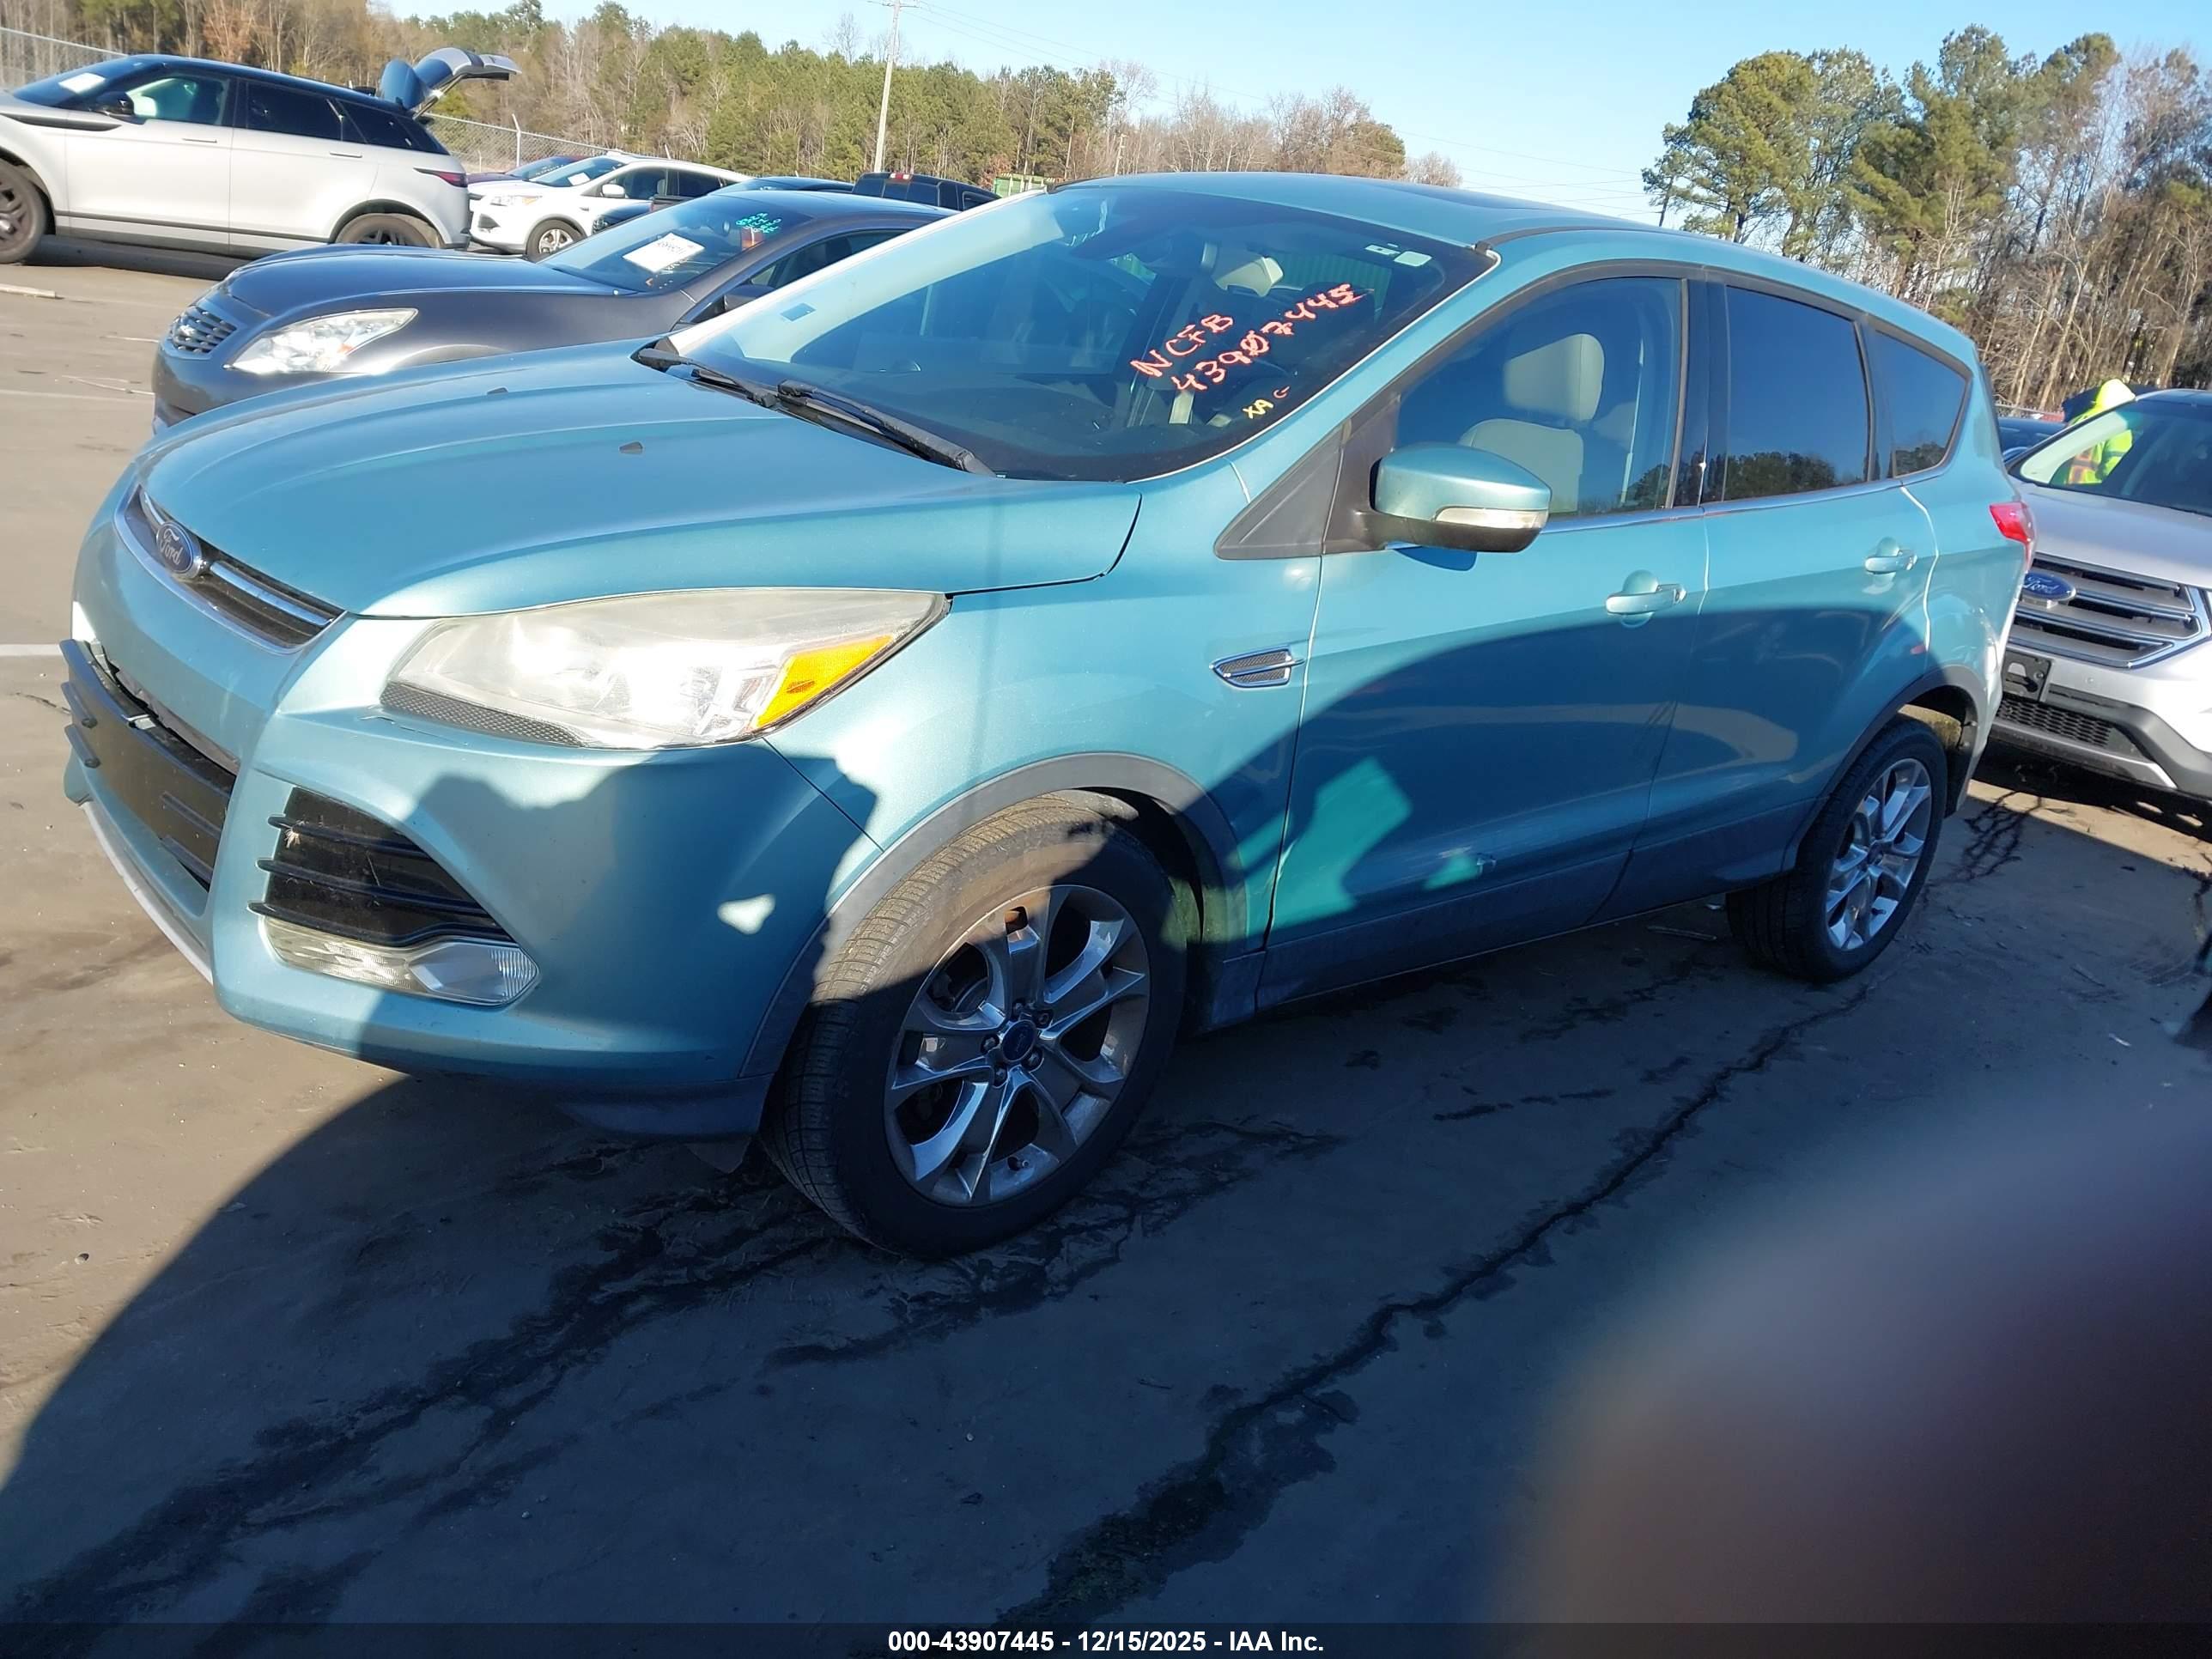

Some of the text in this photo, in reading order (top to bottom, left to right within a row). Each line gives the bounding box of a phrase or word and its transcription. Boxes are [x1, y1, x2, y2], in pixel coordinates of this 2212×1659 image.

[1170, 283, 1362, 392] 43907445
[159, 527, 184, 566] Ford
[2022, 576, 2061, 594] Ford
